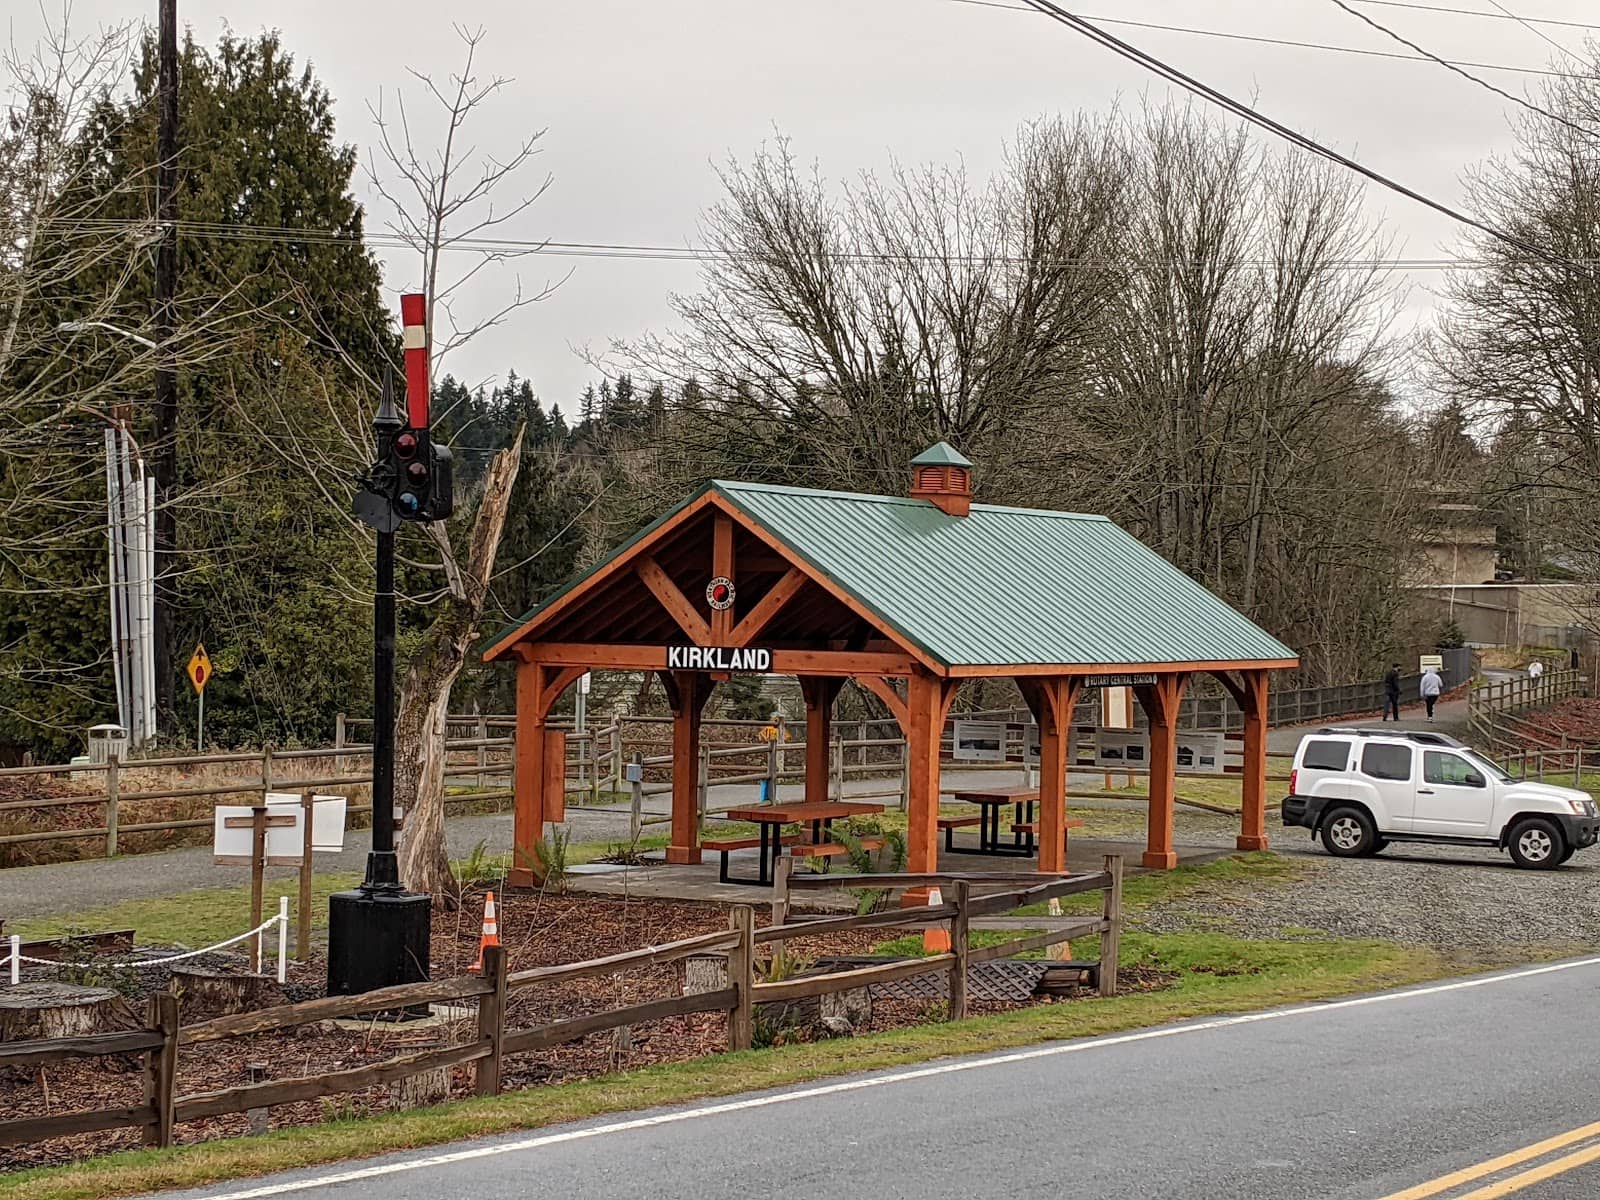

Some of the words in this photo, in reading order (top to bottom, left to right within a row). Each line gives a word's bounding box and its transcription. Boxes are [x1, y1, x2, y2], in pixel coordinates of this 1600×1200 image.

[668, 646, 770, 670] KIRKLAND
[1090, 675, 1110, 686] ROTARY
[1110, 675, 1133, 685] CENTRAL
